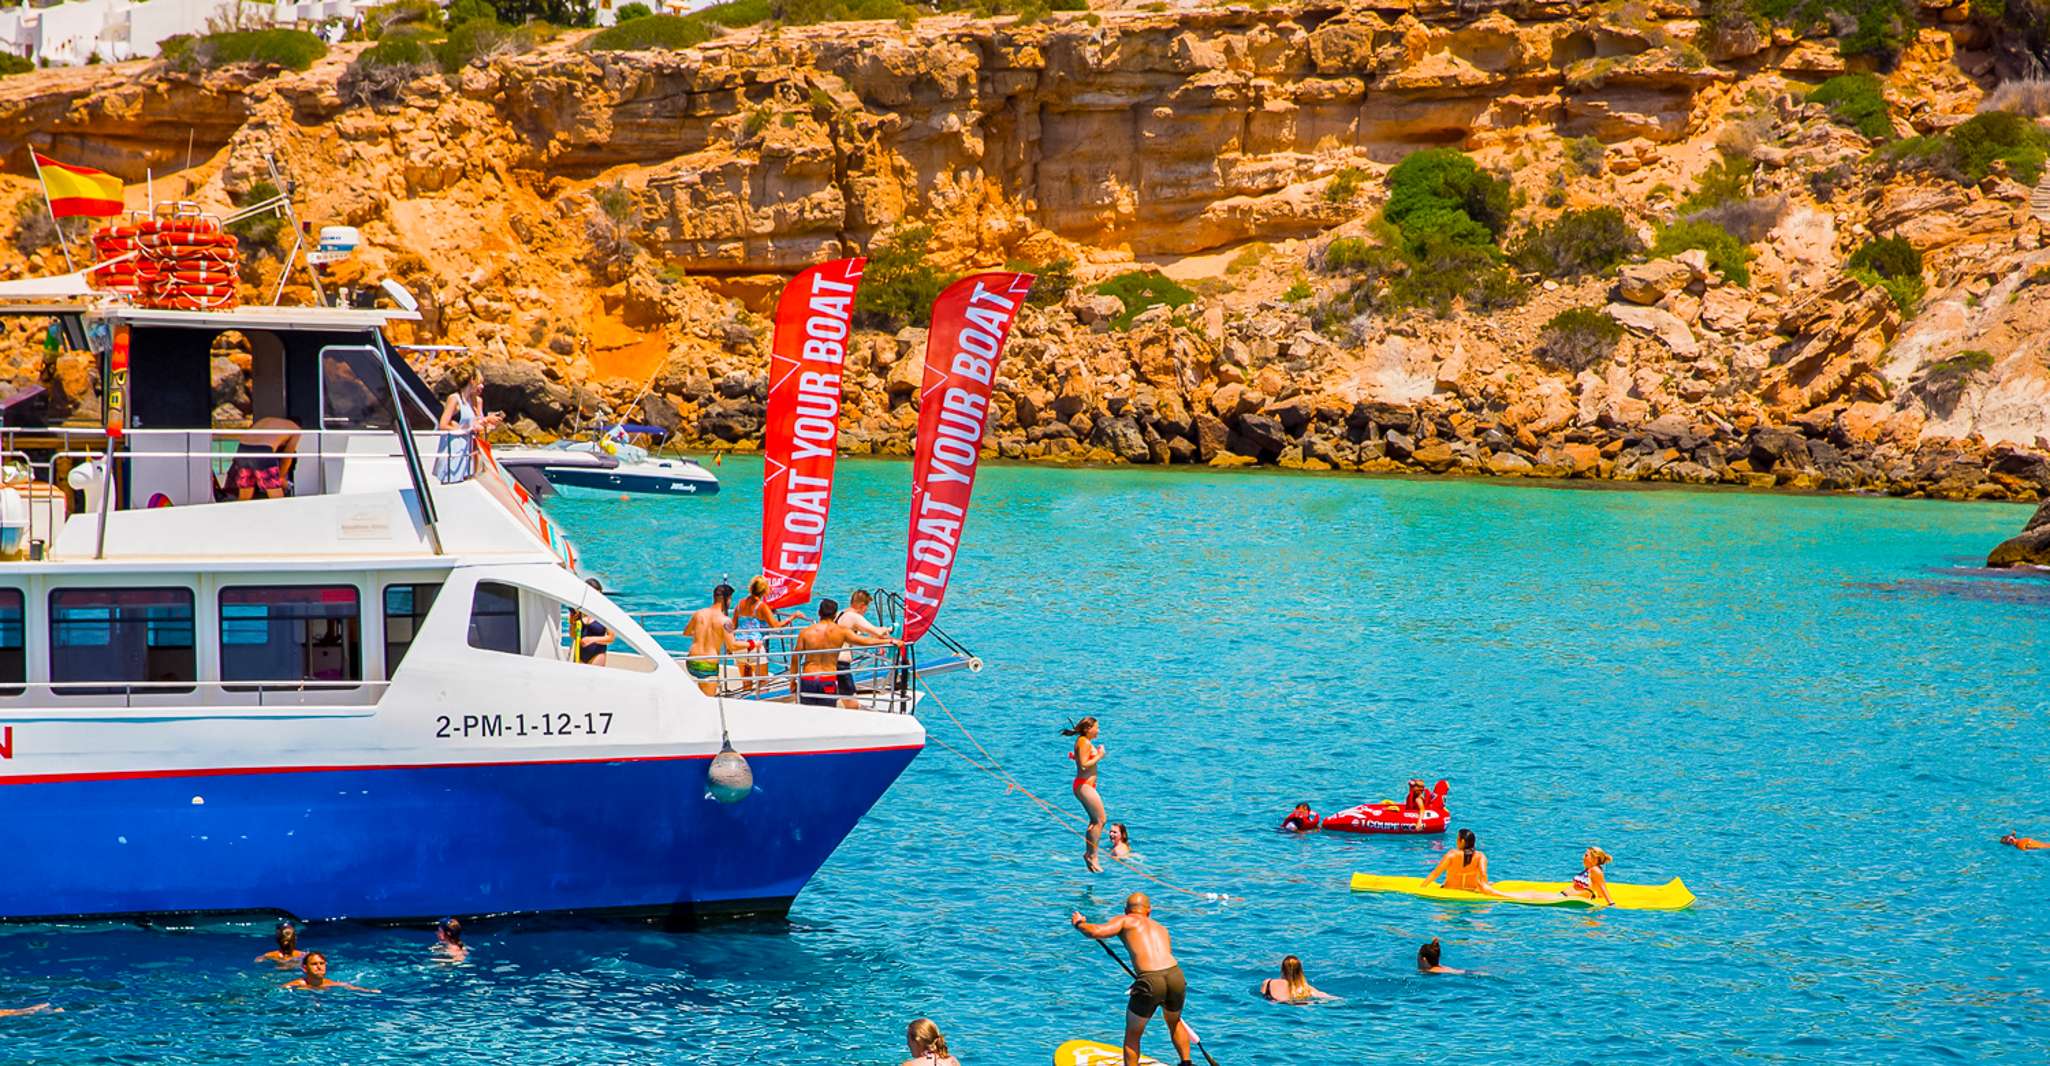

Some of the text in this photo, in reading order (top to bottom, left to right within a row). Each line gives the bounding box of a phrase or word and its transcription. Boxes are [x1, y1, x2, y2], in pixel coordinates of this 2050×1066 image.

[779, 272, 854, 571] FLOAT YOUR BOAT
[905, 281, 1015, 608] FLOAT YOUR BOAT
[435, 712, 614, 738] 2-PM-1-12-17
